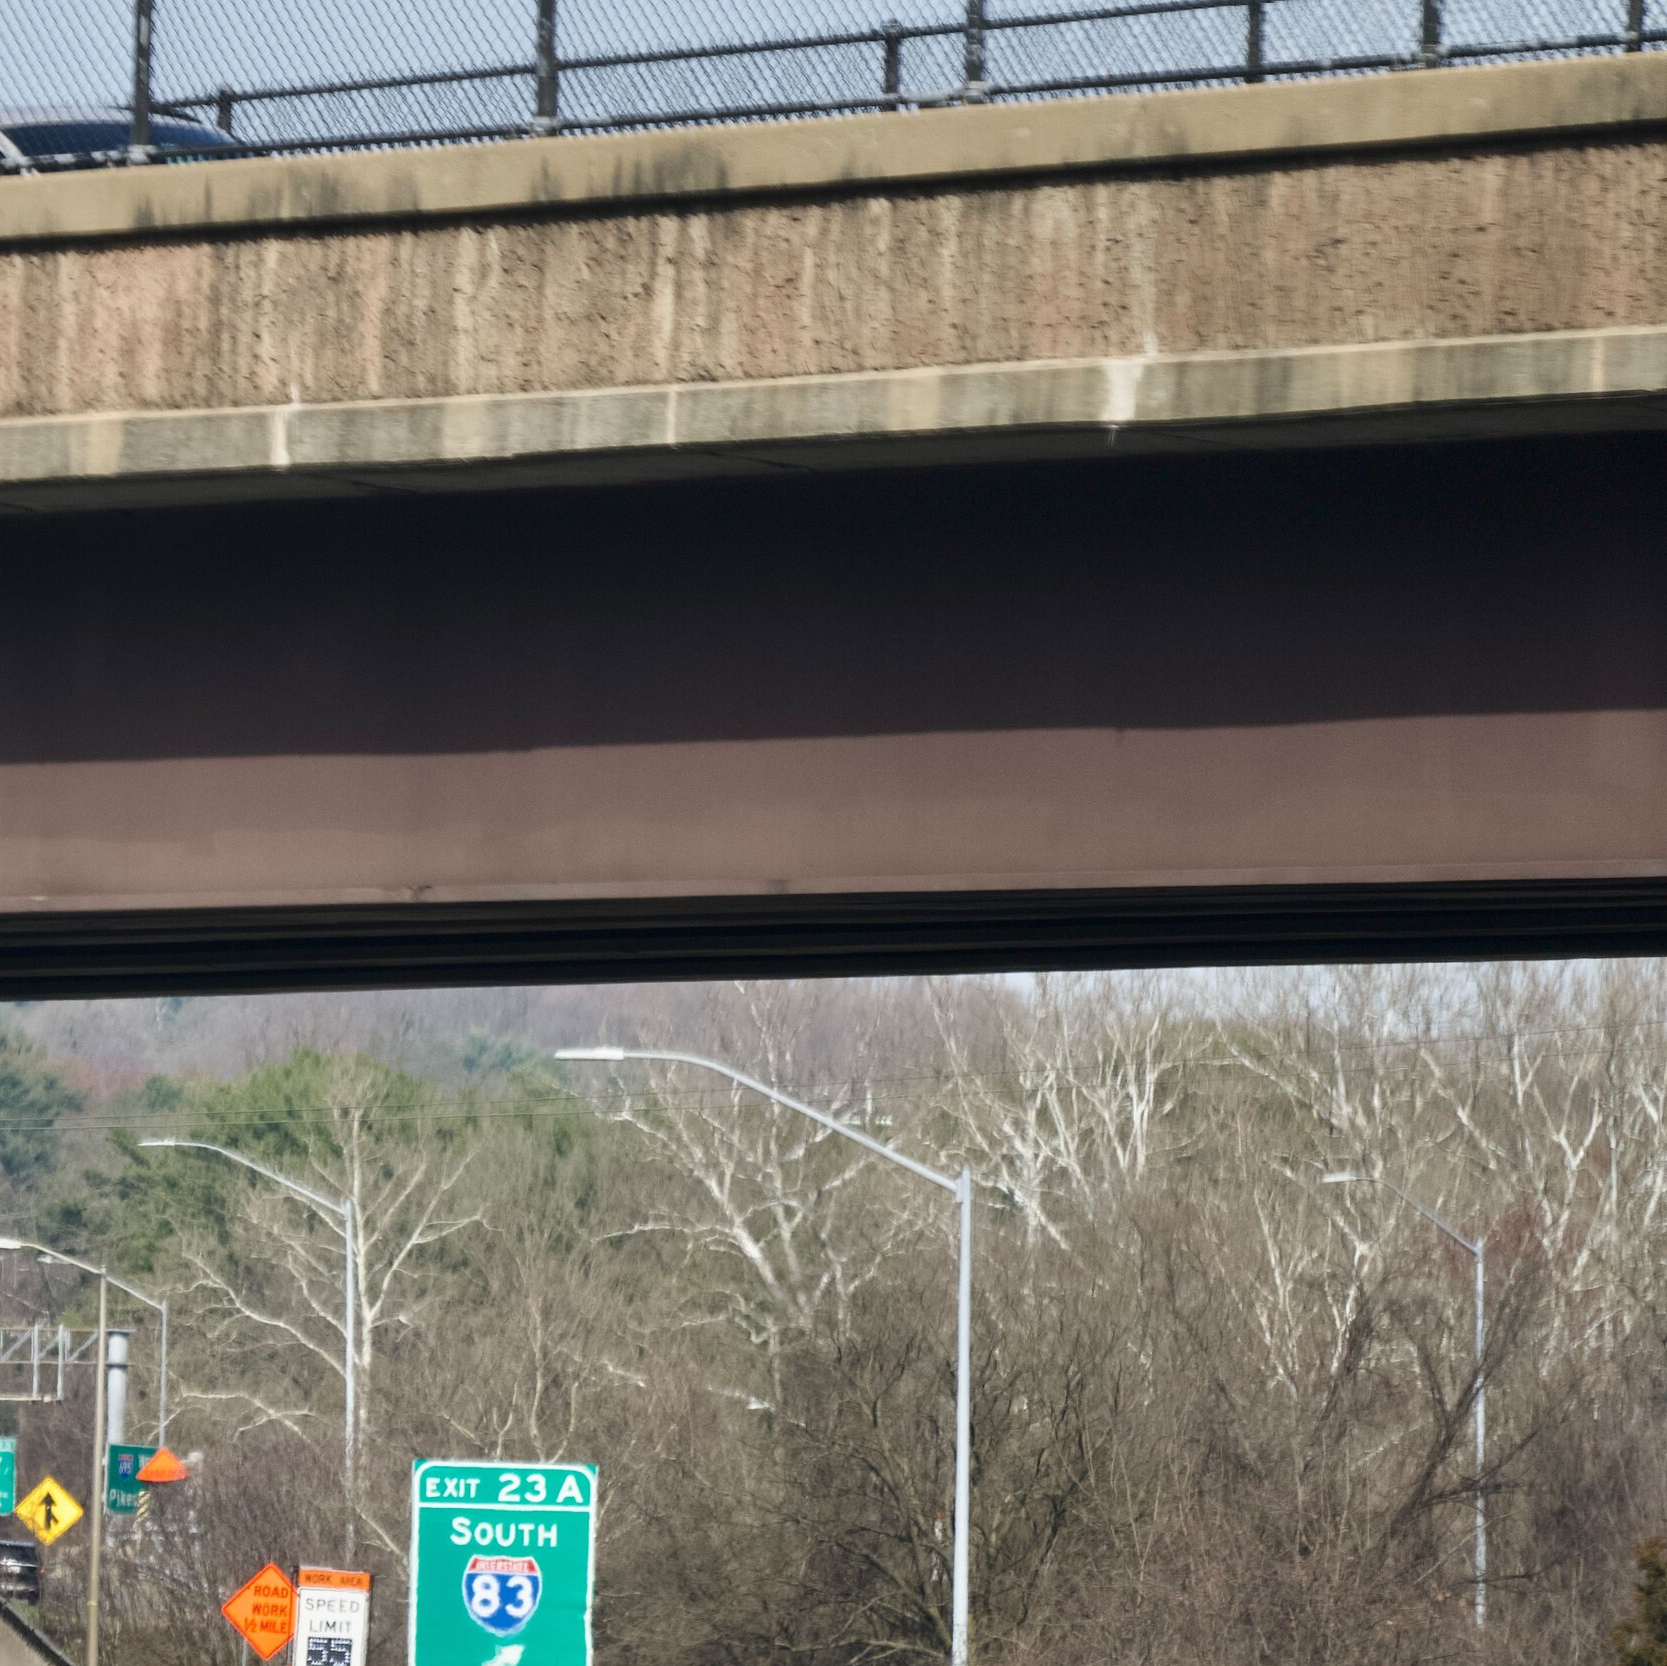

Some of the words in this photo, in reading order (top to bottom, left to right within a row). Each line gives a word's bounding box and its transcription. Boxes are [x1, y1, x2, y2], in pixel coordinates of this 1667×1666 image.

[426, 1477, 481, 1498] EXIT
[498, 1473, 547, 1503] 23
[556, 1474, 584, 1503] A
[450, 1516, 557, 1547] SOUTH
[305, 1575, 331, 1585] WORK
[341, 1576, 363, 1586] AREA
[254, 1586, 288, 1599] ROAD
[471, 1574, 534, 1618] 83
[252, 1603, 288, 1617] WORK
[305, 1598, 360, 1613] SPEED
[260, 1620, 288, 1634] MILE
[309, 1620, 352, 1633] LIMIT
